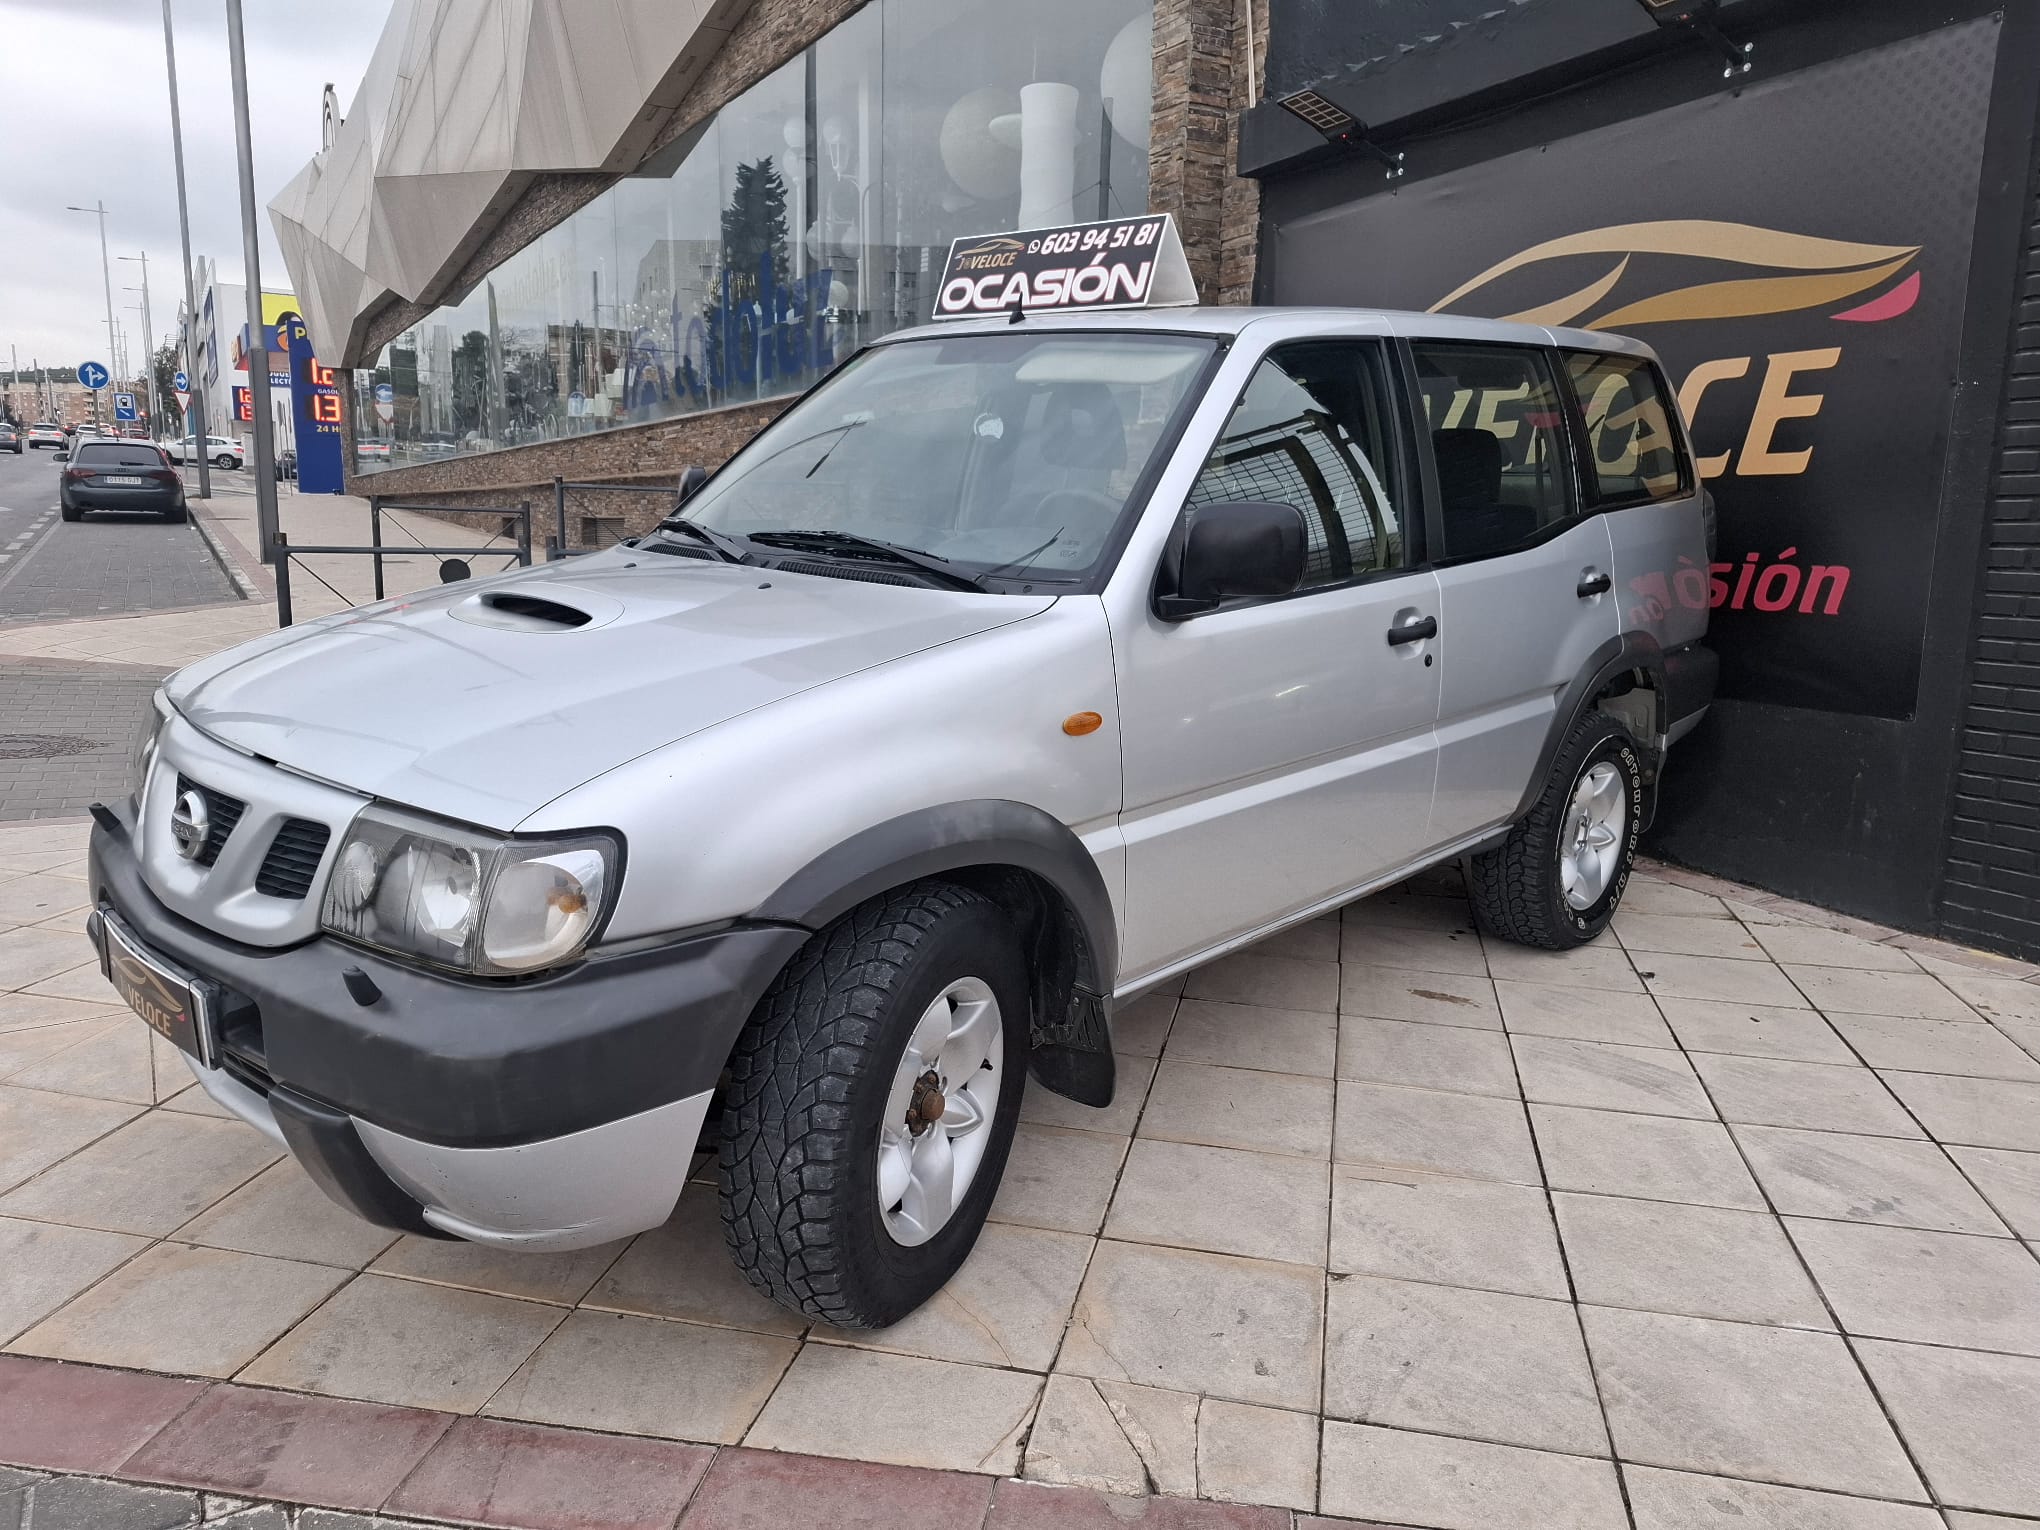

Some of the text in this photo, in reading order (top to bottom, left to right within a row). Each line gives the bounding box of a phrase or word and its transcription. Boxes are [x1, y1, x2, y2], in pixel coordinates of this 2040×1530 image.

[1041, 222, 1161, 255] 603 94 51 81
[941, 251, 1152, 312] OCASIÓN
[316, 424, 329, 433] 24
